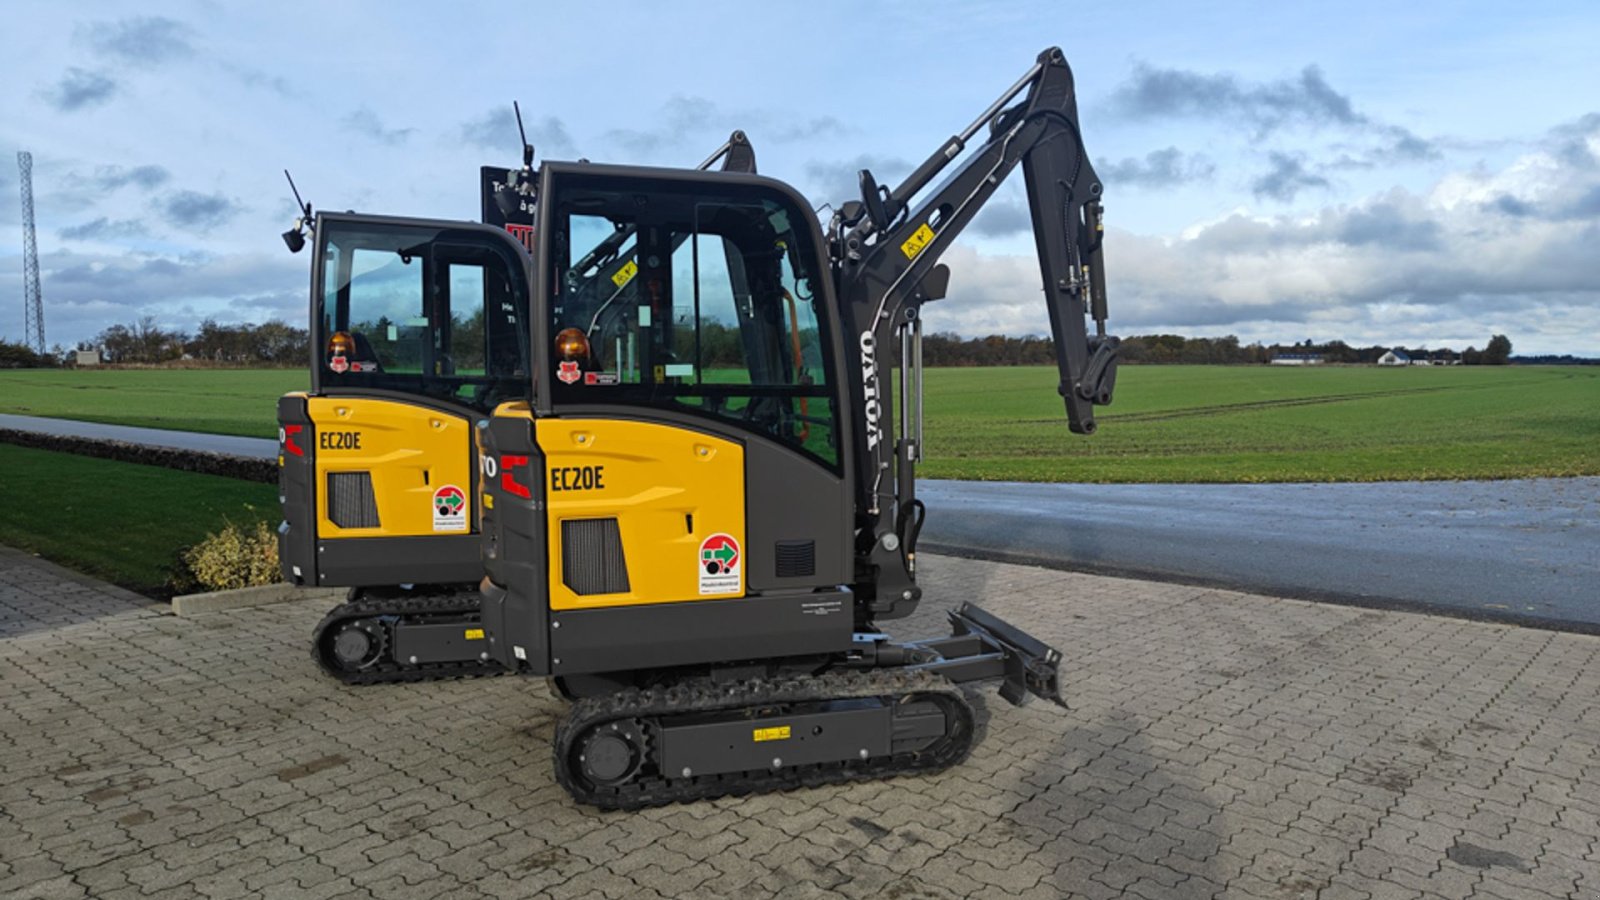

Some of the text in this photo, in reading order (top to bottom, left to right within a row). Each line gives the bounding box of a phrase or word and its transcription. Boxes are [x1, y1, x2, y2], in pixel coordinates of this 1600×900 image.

[860, 331, 882, 452] VOLVO
[319, 432, 361, 449] EC20E
[551, 466, 604, 491] EC20E
